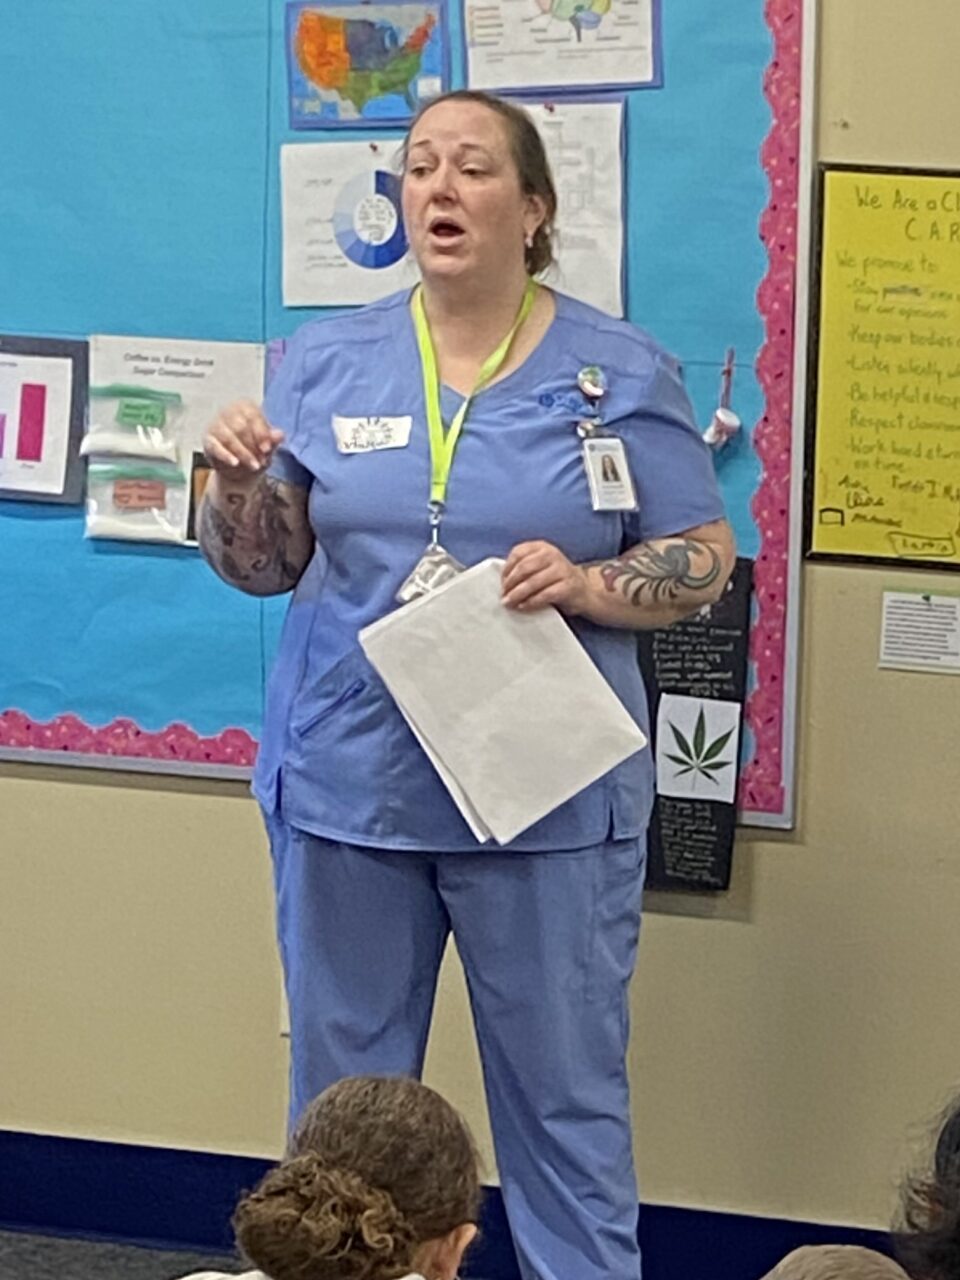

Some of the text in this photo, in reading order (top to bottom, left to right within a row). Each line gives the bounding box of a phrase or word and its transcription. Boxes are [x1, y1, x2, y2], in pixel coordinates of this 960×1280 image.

[855, 186, 882, 209] We
[892, 190, 919, 211] Are
[926, 200, 937, 211] a
